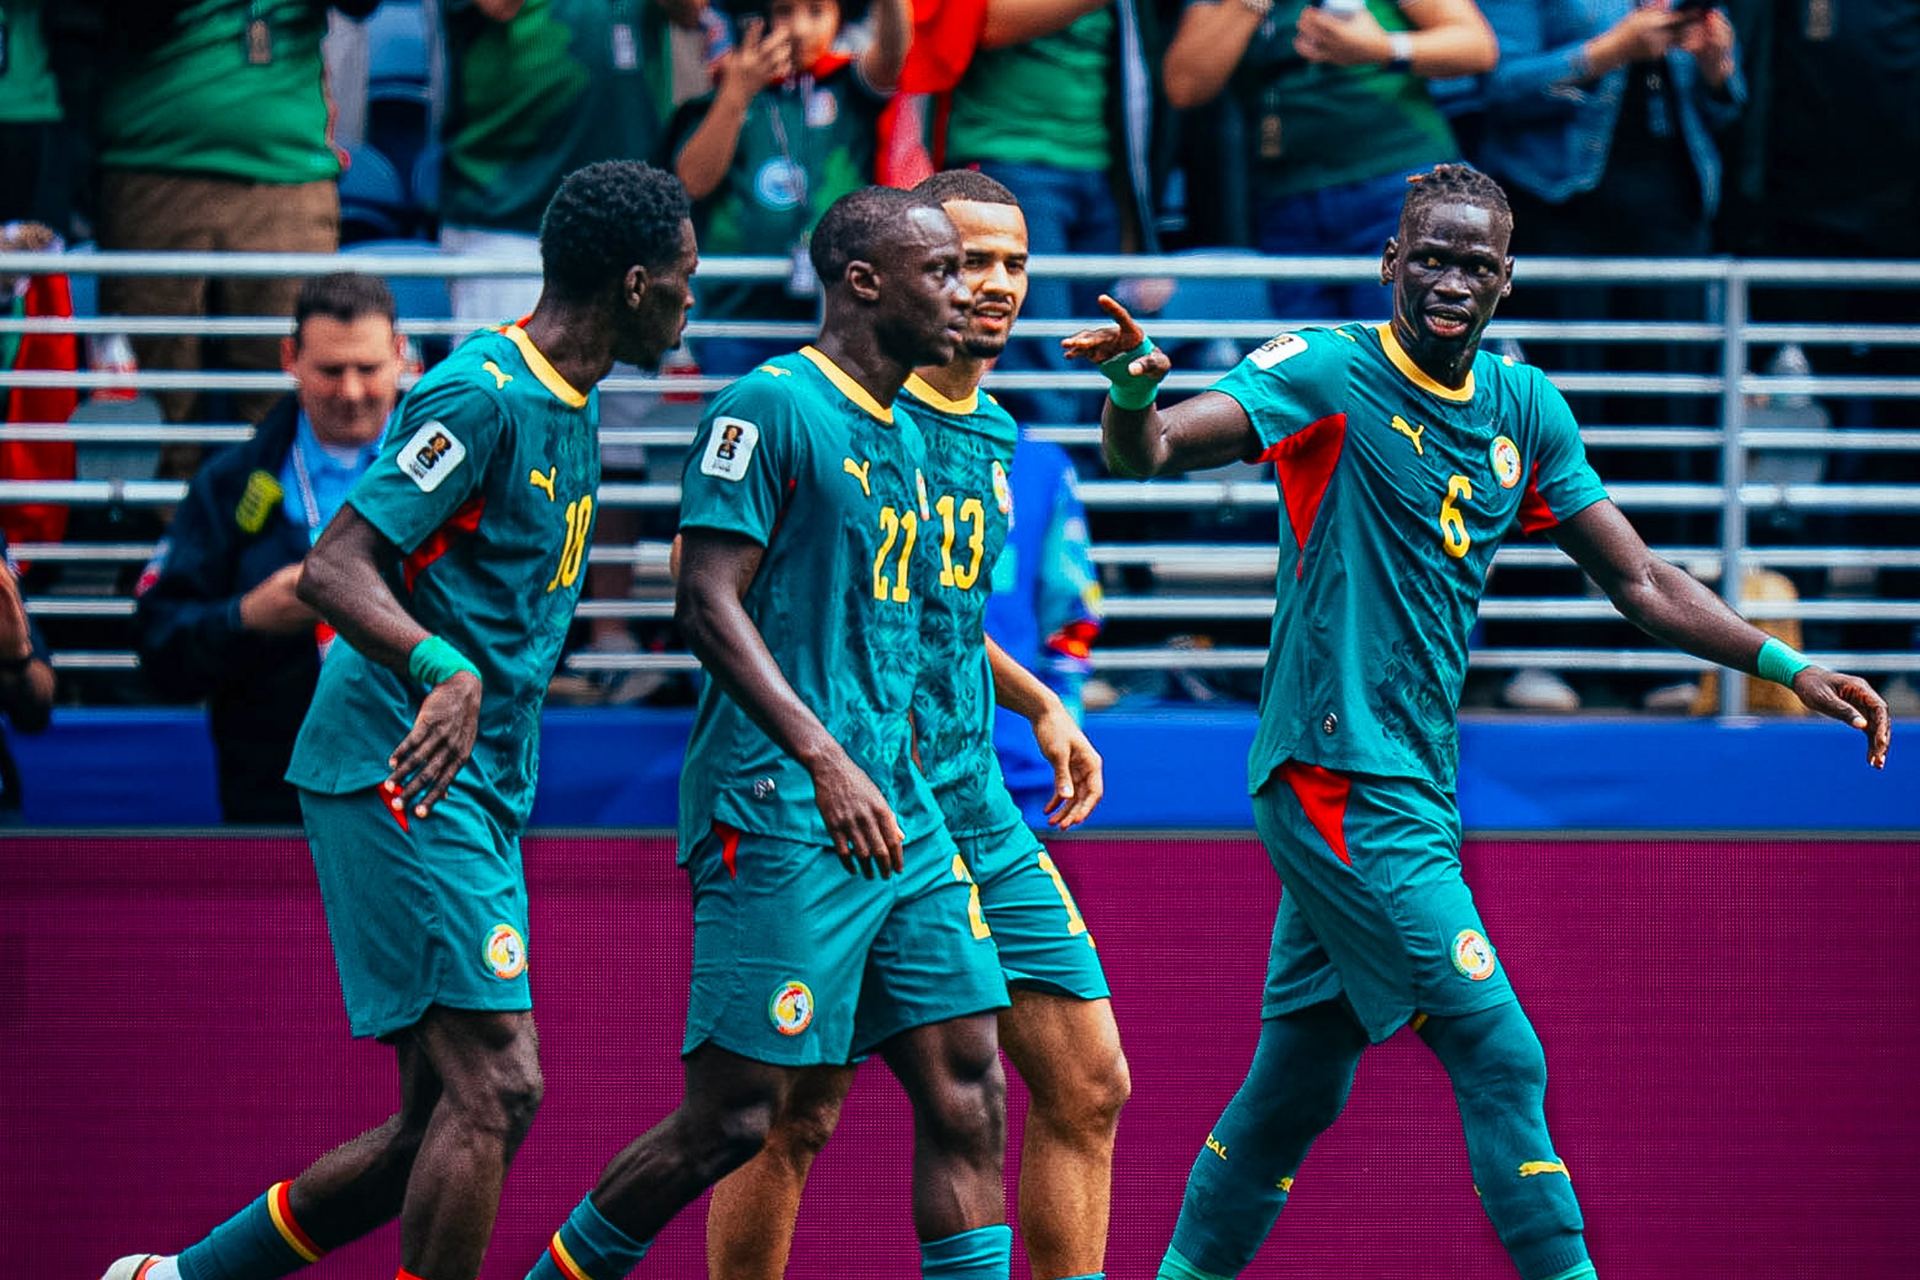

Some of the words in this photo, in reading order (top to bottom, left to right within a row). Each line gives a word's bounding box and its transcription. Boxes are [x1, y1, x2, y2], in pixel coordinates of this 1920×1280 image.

[547, 494, 592, 593] 18
[873, 506, 917, 603] 21
[936, 495, 984, 590] 13
[1440, 474, 1472, 558] 6
